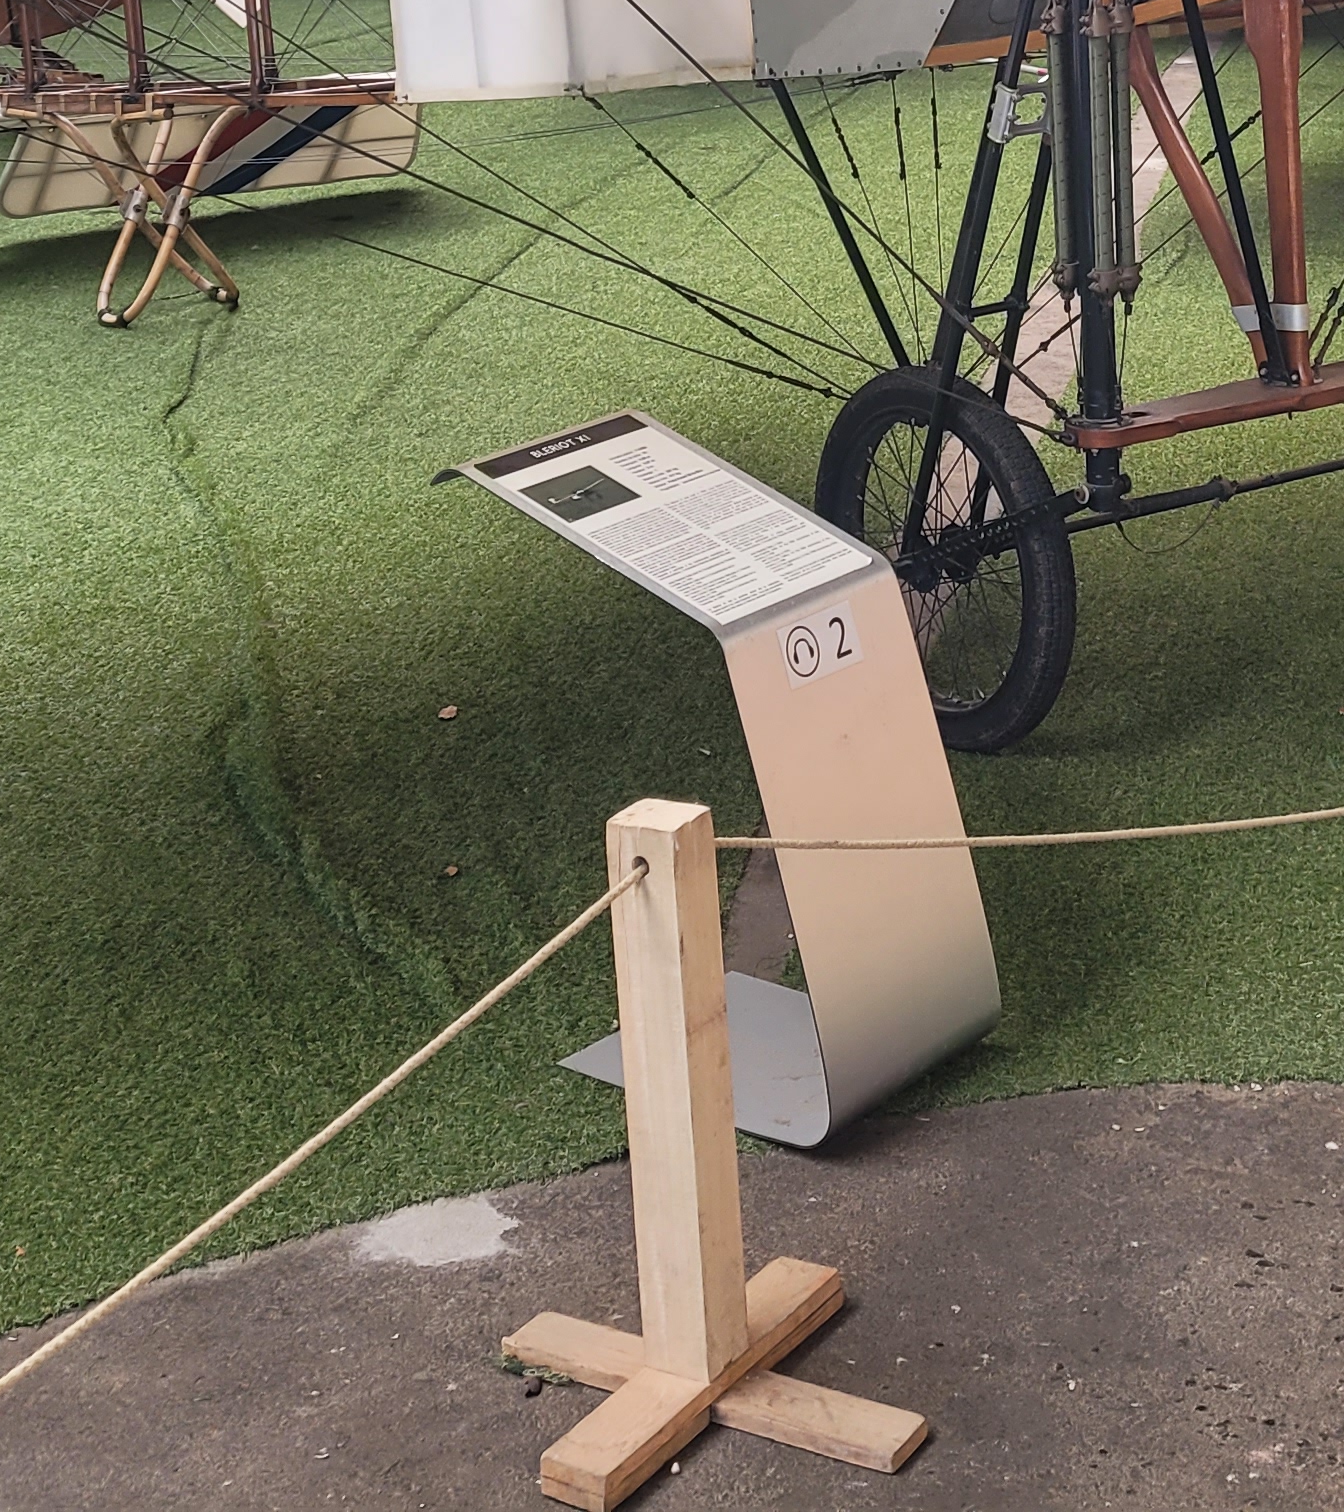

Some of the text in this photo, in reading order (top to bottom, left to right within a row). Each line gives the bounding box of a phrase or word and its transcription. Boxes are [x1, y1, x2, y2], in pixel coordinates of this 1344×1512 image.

[529, 433, 592, 459] BLERIOT XI
[828, 616, 853, 660] 2
